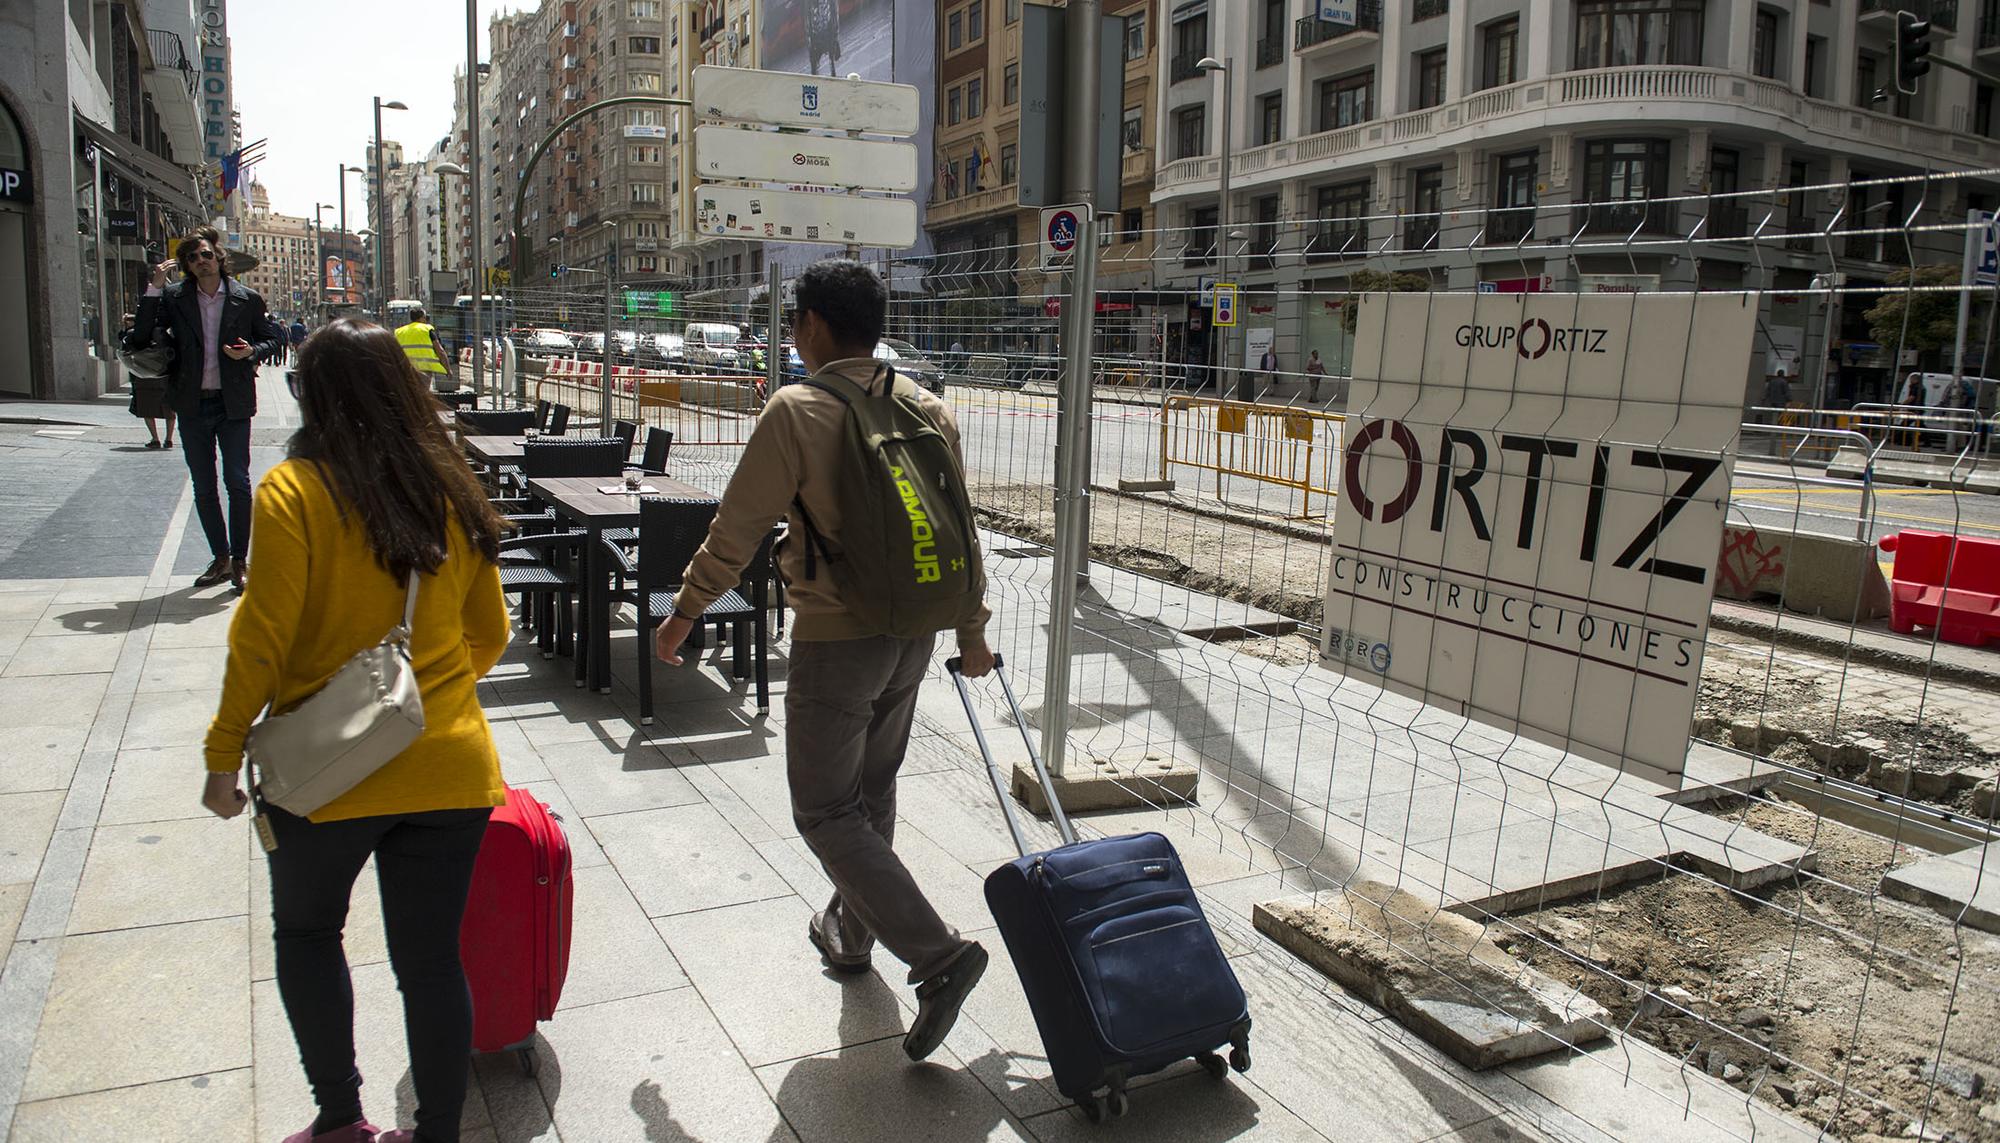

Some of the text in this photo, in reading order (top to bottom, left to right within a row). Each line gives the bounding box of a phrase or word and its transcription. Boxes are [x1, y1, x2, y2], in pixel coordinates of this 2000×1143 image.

[204, 56, 225, 158] HOTEL
[0, 170, 20, 196] P
[806, 159, 830, 167] MOSA
[1597, 283, 1641, 293] Popular
[889, 463, 941, 583] ARMOUR
[1345, 418, 1722, 585] ORTIZ
[1334, 556, 1691, 667] CONSTRUCCIONES
